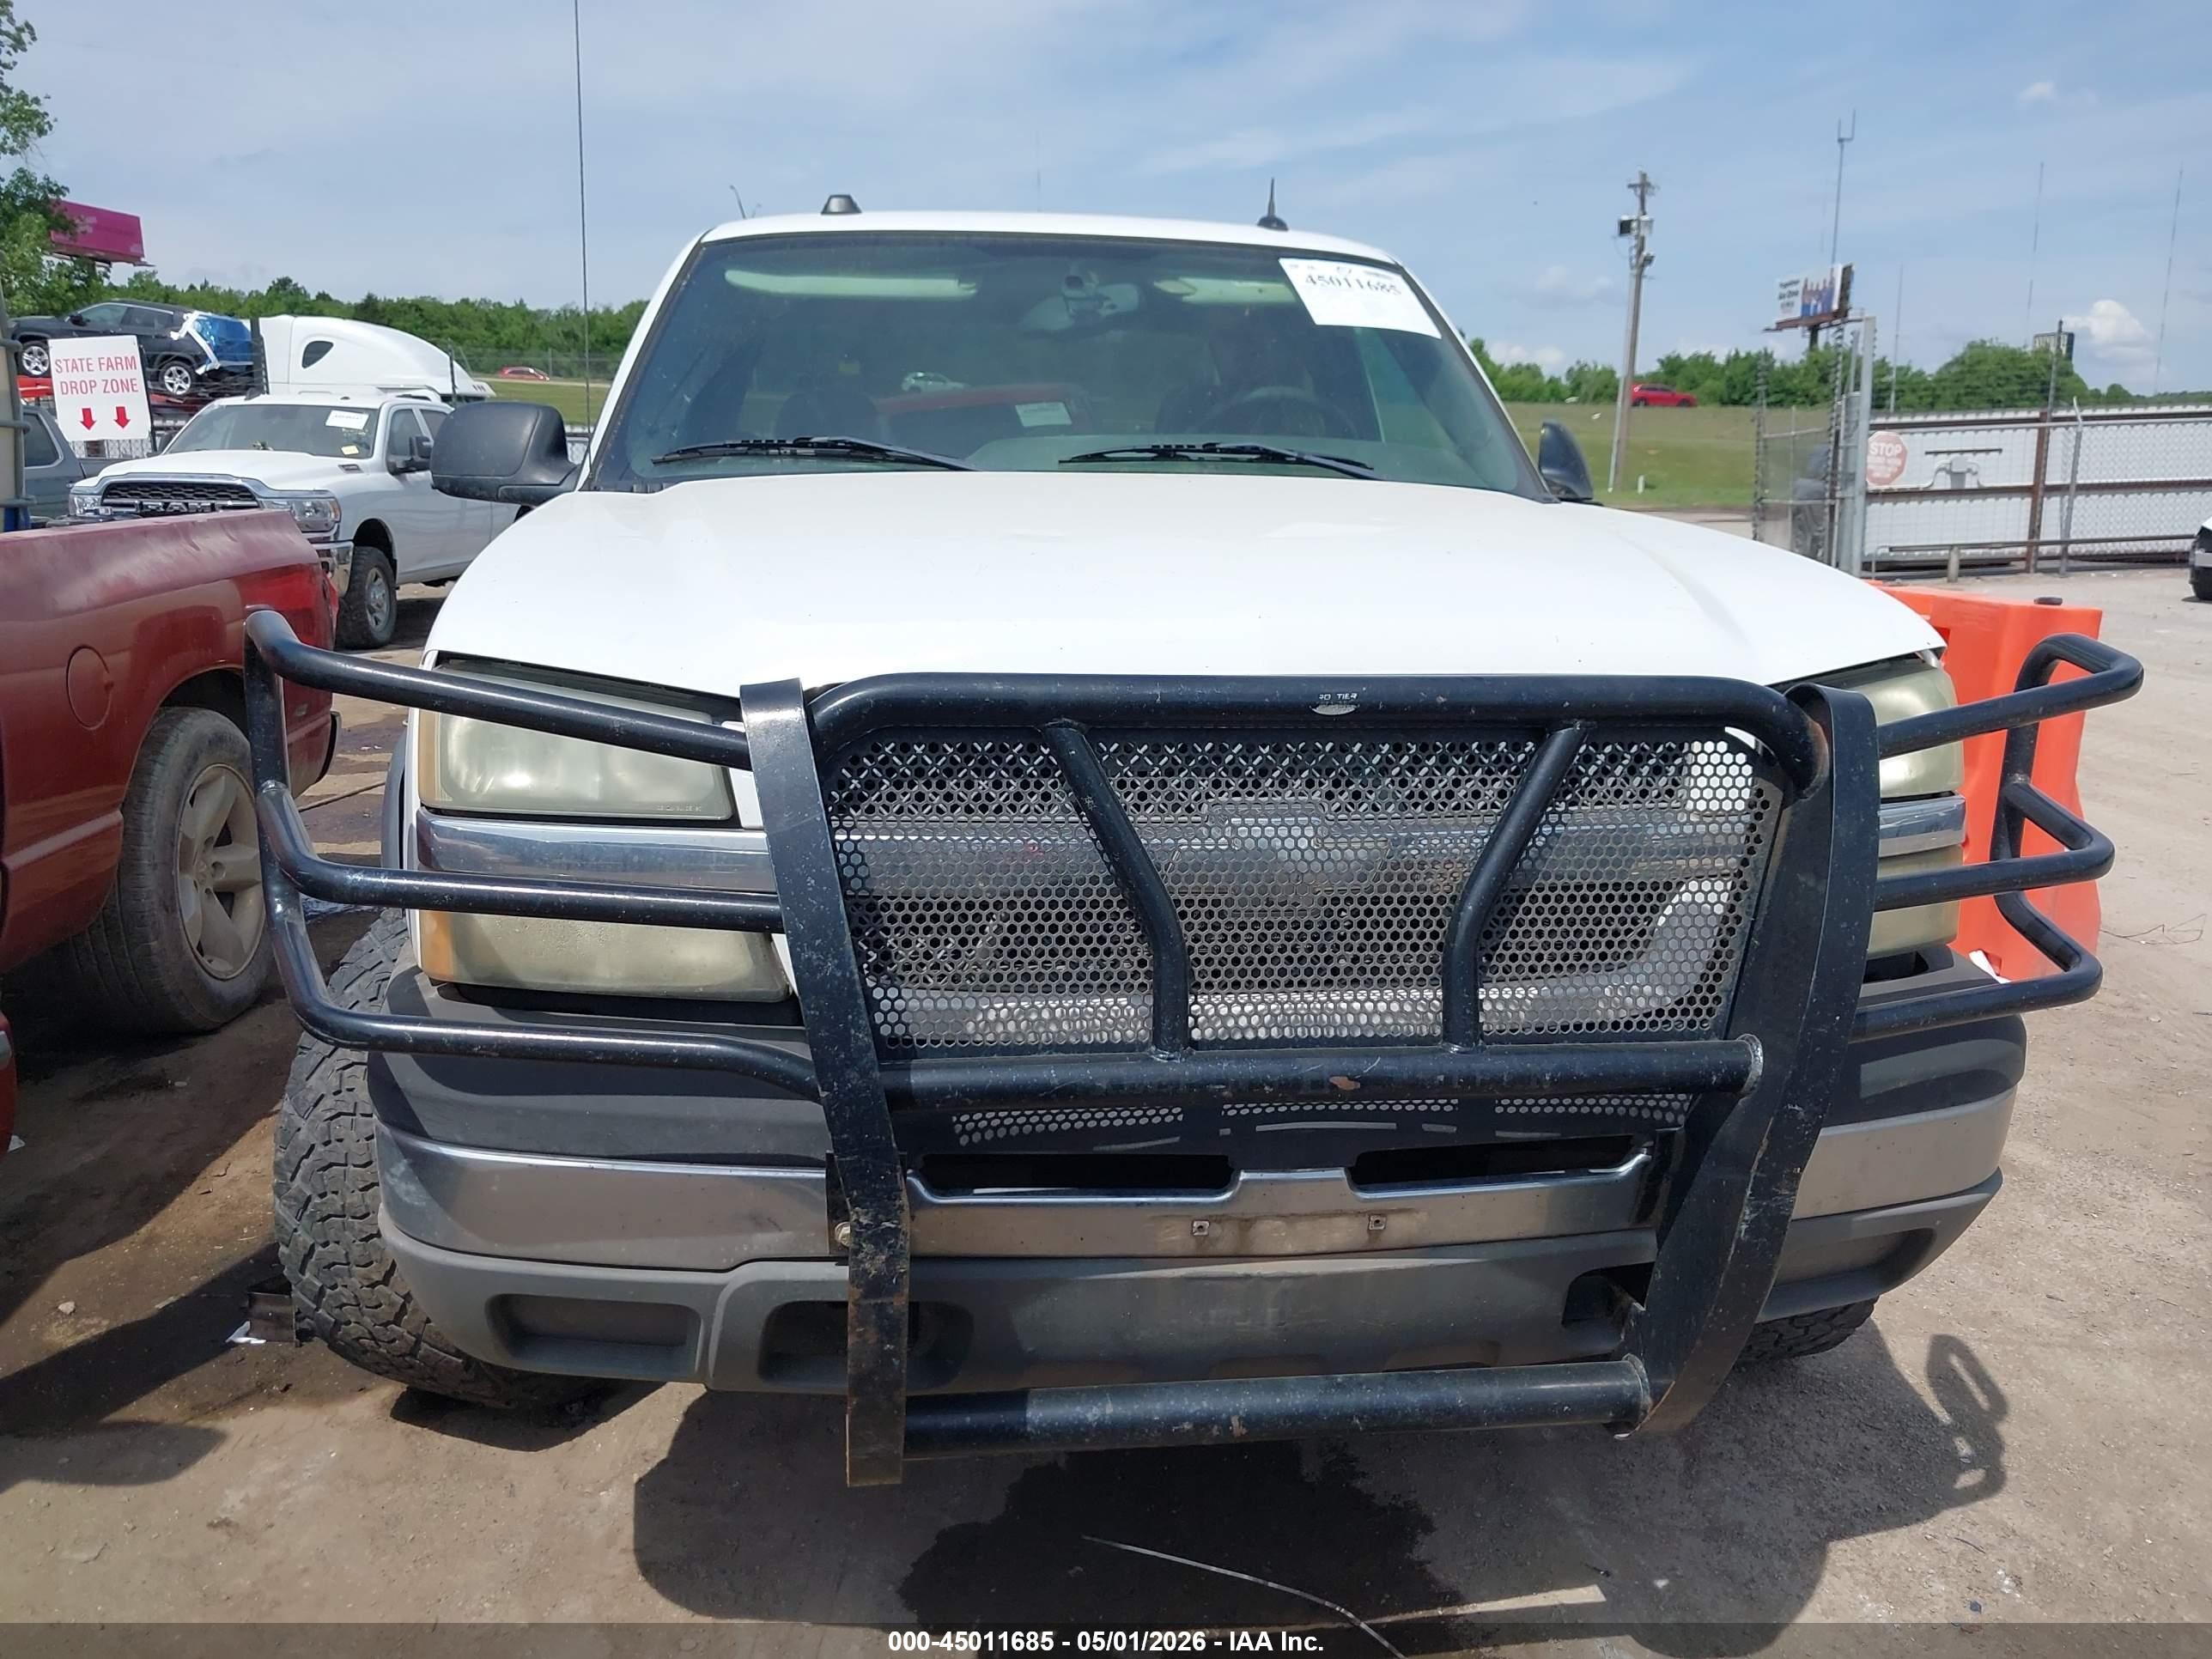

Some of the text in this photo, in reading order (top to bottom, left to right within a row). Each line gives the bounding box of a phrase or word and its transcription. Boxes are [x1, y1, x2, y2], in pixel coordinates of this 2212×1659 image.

[1304, 274, 1403, 295] 45011685
[55, 356, 137, 374] STATE FARM
[60, 378, 139, 395] DROP ZONE
[1869, 441, 1903, 457] STOP
[141, 501, 211, 513] RAM
